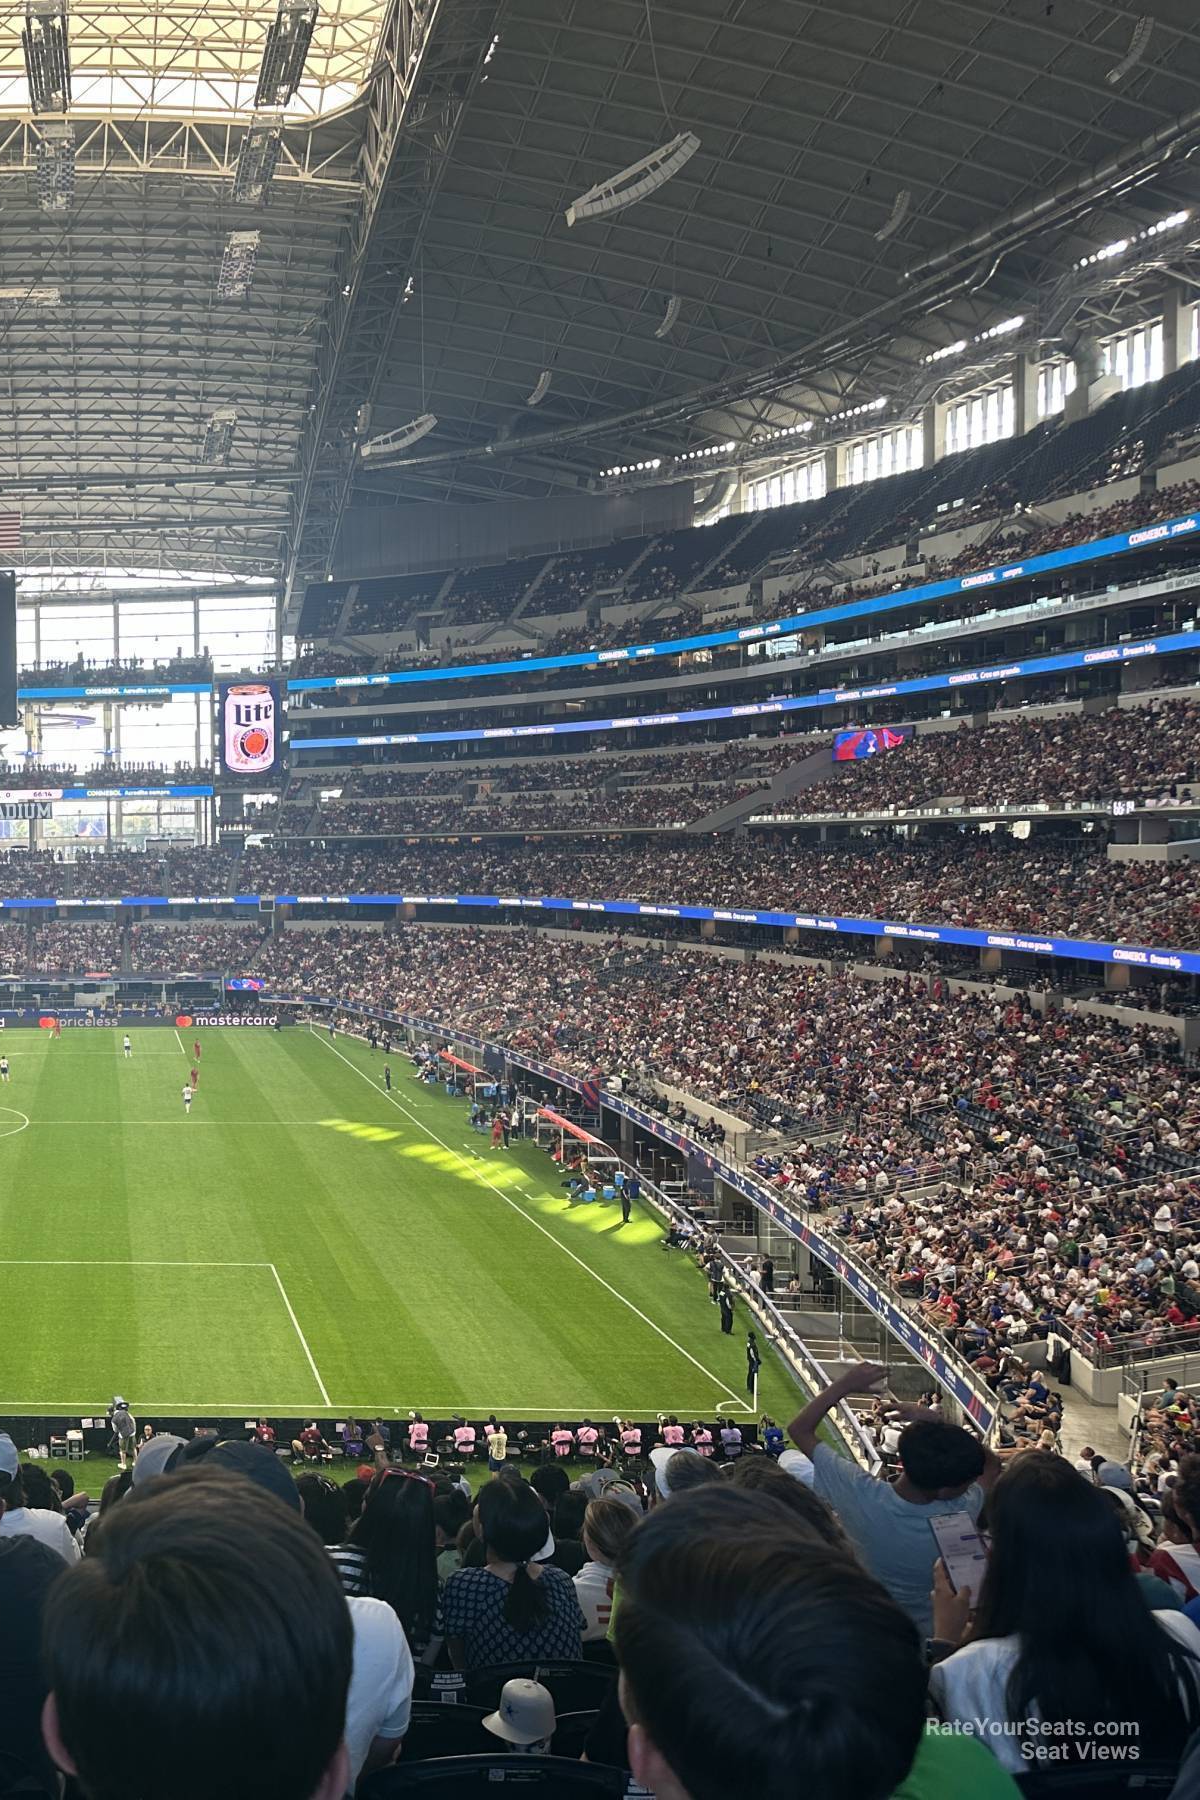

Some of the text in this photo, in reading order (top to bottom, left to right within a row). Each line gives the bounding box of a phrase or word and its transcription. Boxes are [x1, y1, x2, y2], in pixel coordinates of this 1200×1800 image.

[1128, 525, 1169, 545] CONMEBOL
[85, 686, 121, 695] CONMEBOL
[234, 702, 272, 727] Lite
[86, 788, 122, 797] CONMEBOL
[59, 1016, 119, 1028] priceless
[196, 1015, 278, 1026] mastercard
